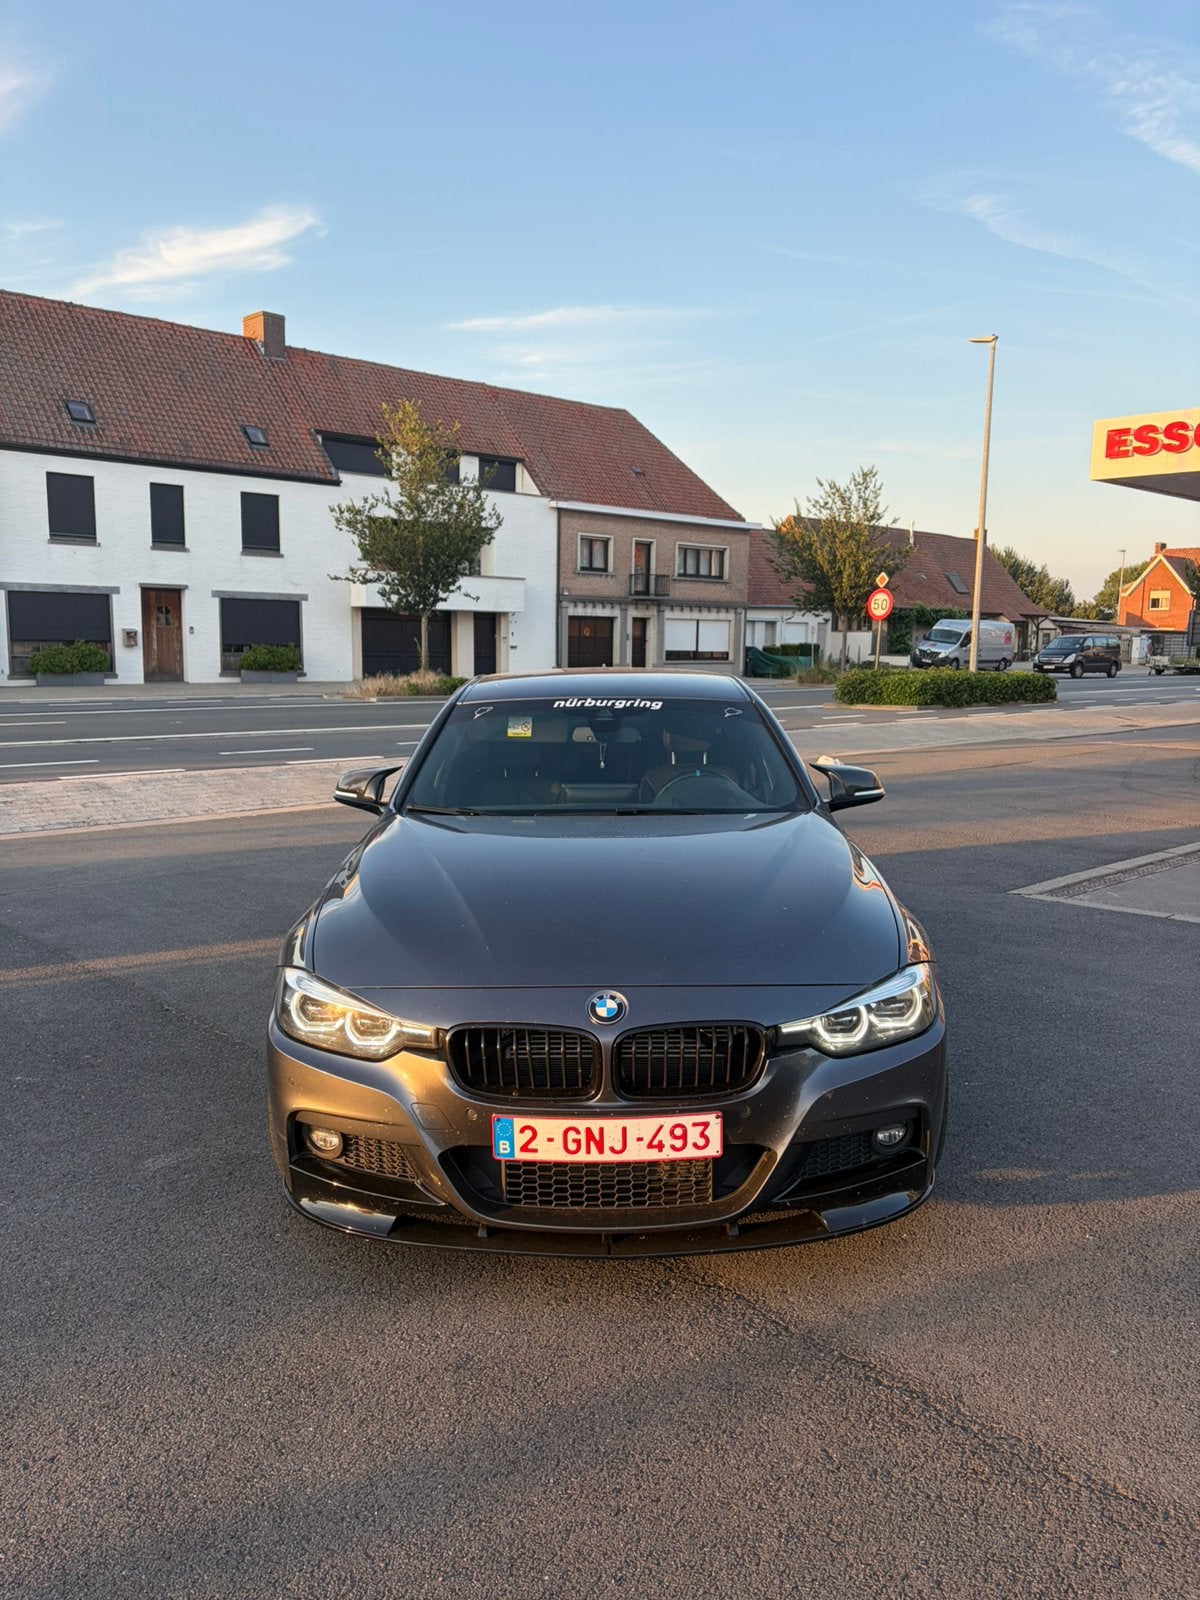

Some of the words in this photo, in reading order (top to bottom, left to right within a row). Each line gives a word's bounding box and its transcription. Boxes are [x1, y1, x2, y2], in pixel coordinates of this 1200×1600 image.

[1105, 421, 1200, 459] ESS
[873, 598, 888, 611] 50
[553, 698, 663, 710] nürburgring
[593, 994, 621, 1004] BMW
[519, 1121, 710, 1155] 2-GNJ-493
[500, 1141, 511, 1154] B
